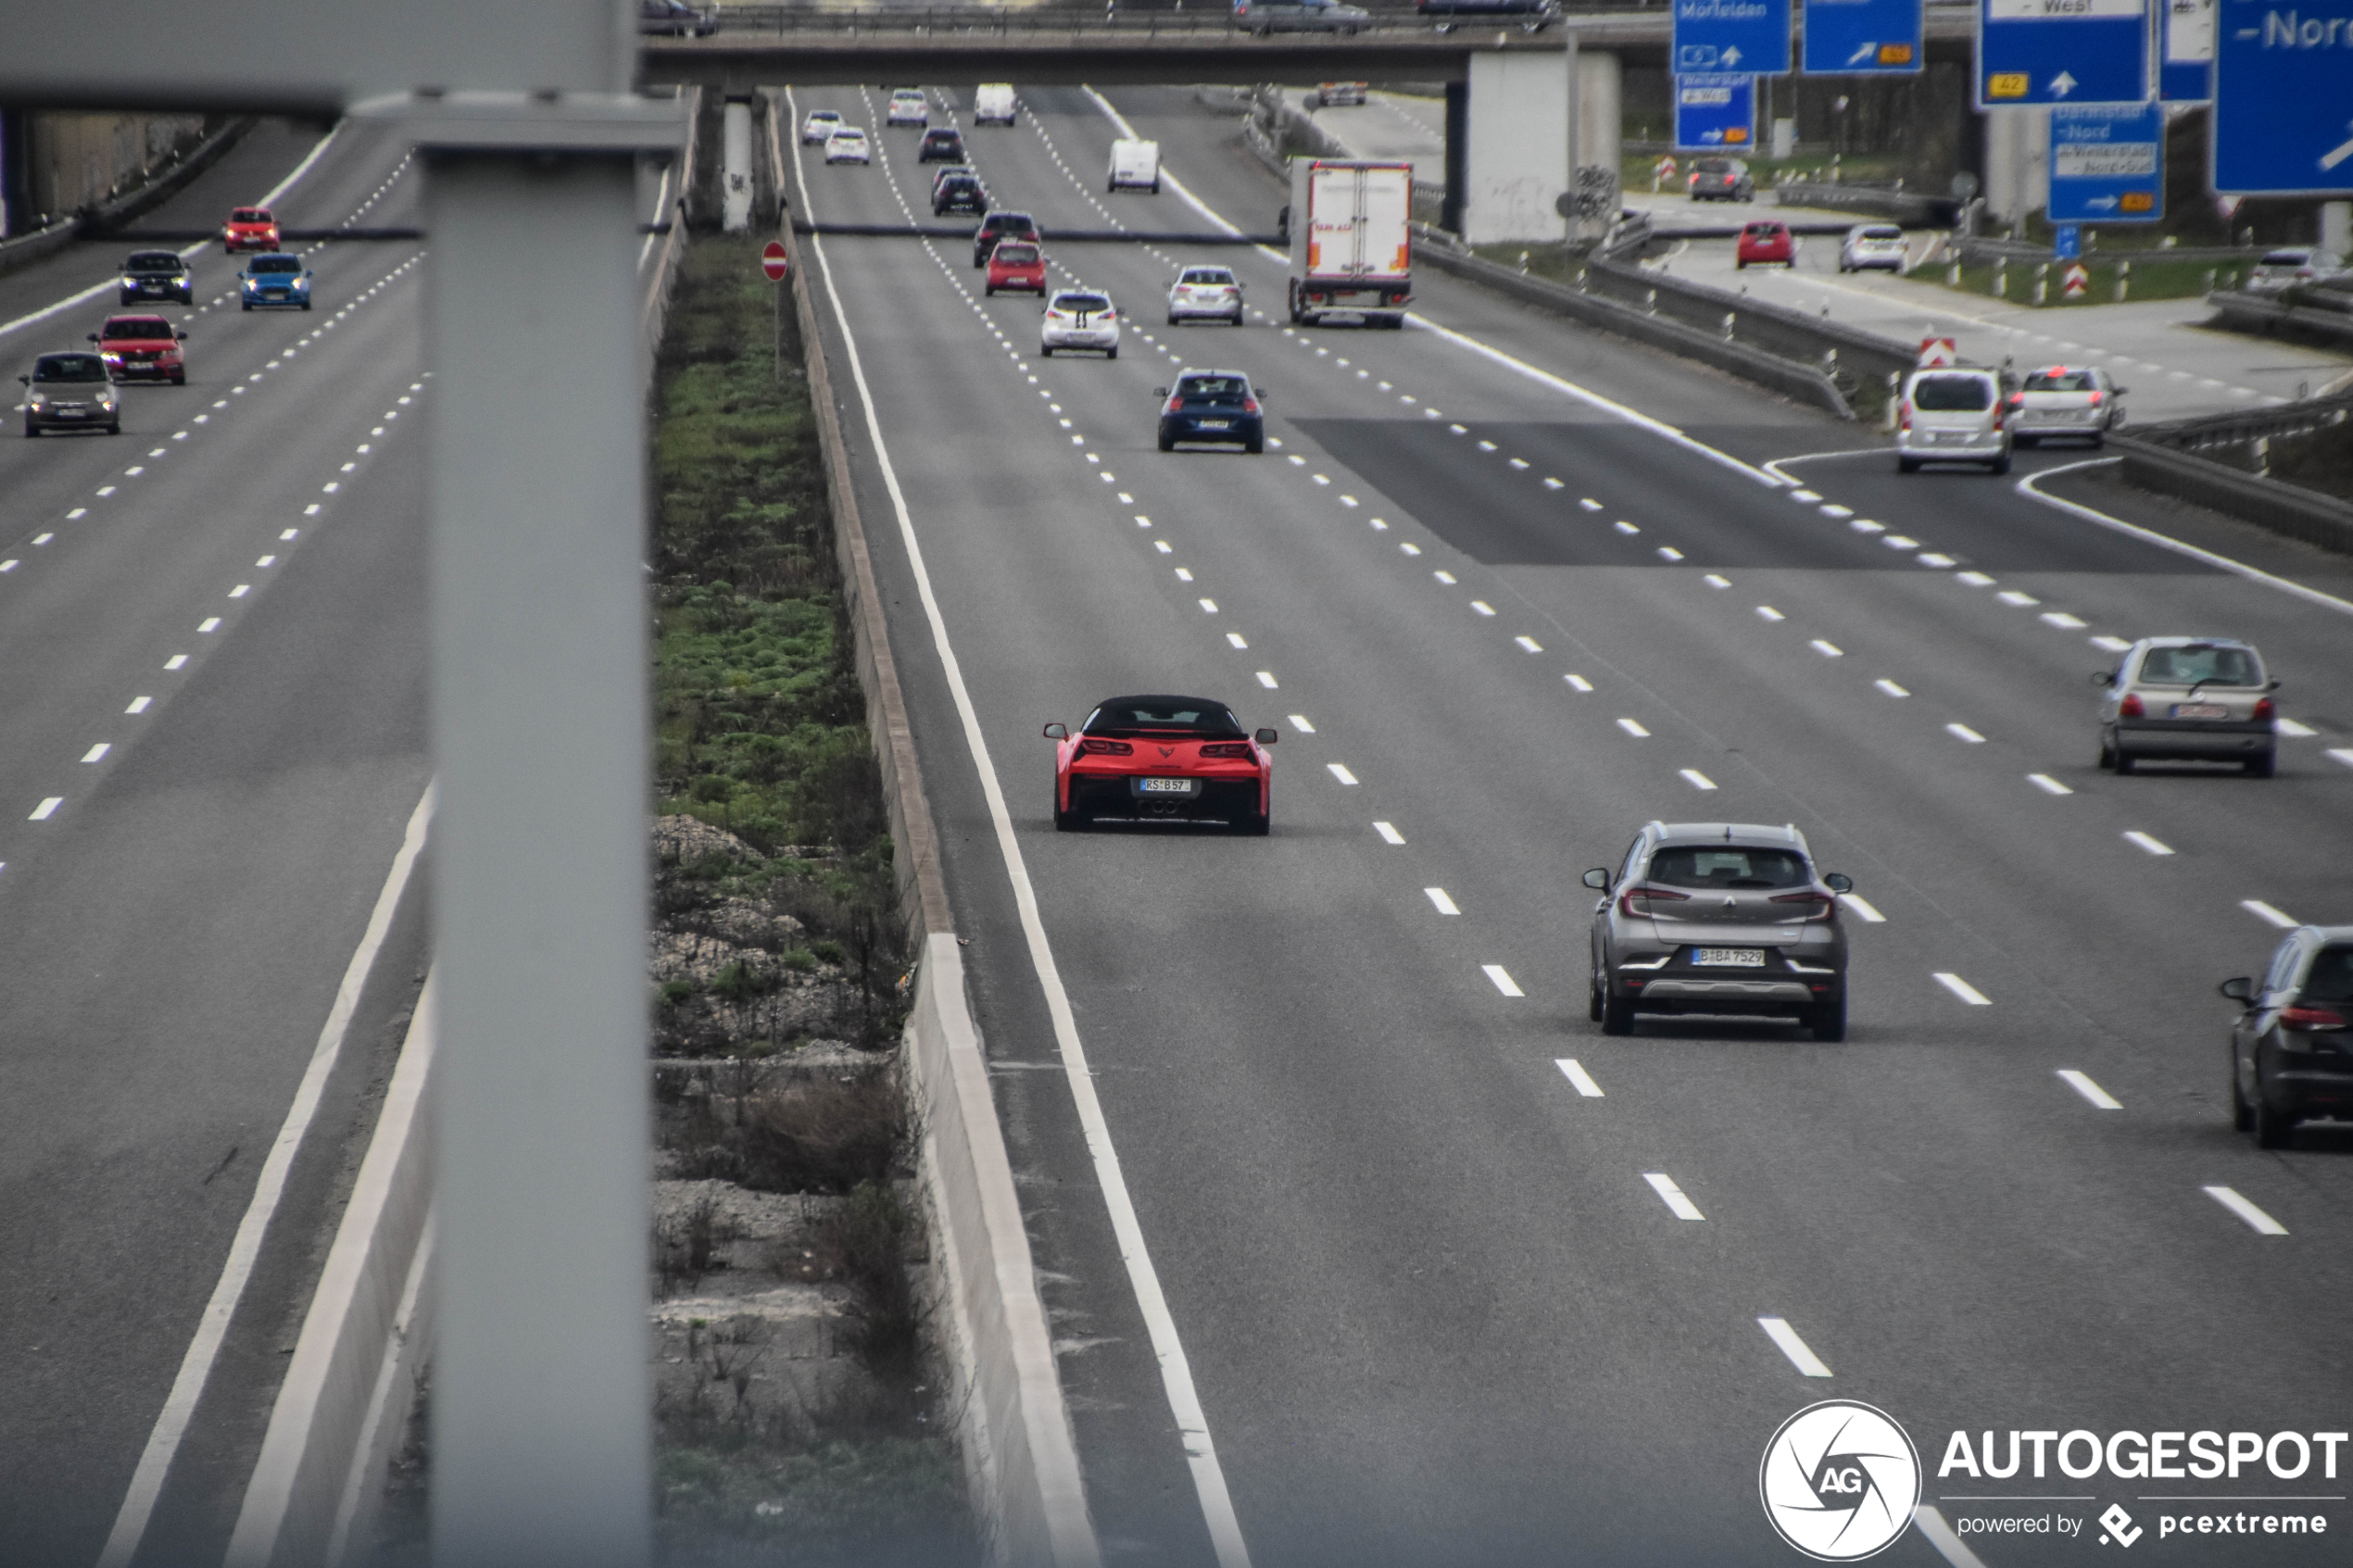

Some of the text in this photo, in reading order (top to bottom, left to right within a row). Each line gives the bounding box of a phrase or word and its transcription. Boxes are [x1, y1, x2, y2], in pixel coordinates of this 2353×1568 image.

[2000, 76, 2020, 90] 42
[1147, 780, 1159, 790] RS
[1701, 950, 1708, 961] B
[1733, 951, 1763, 962] 7529
